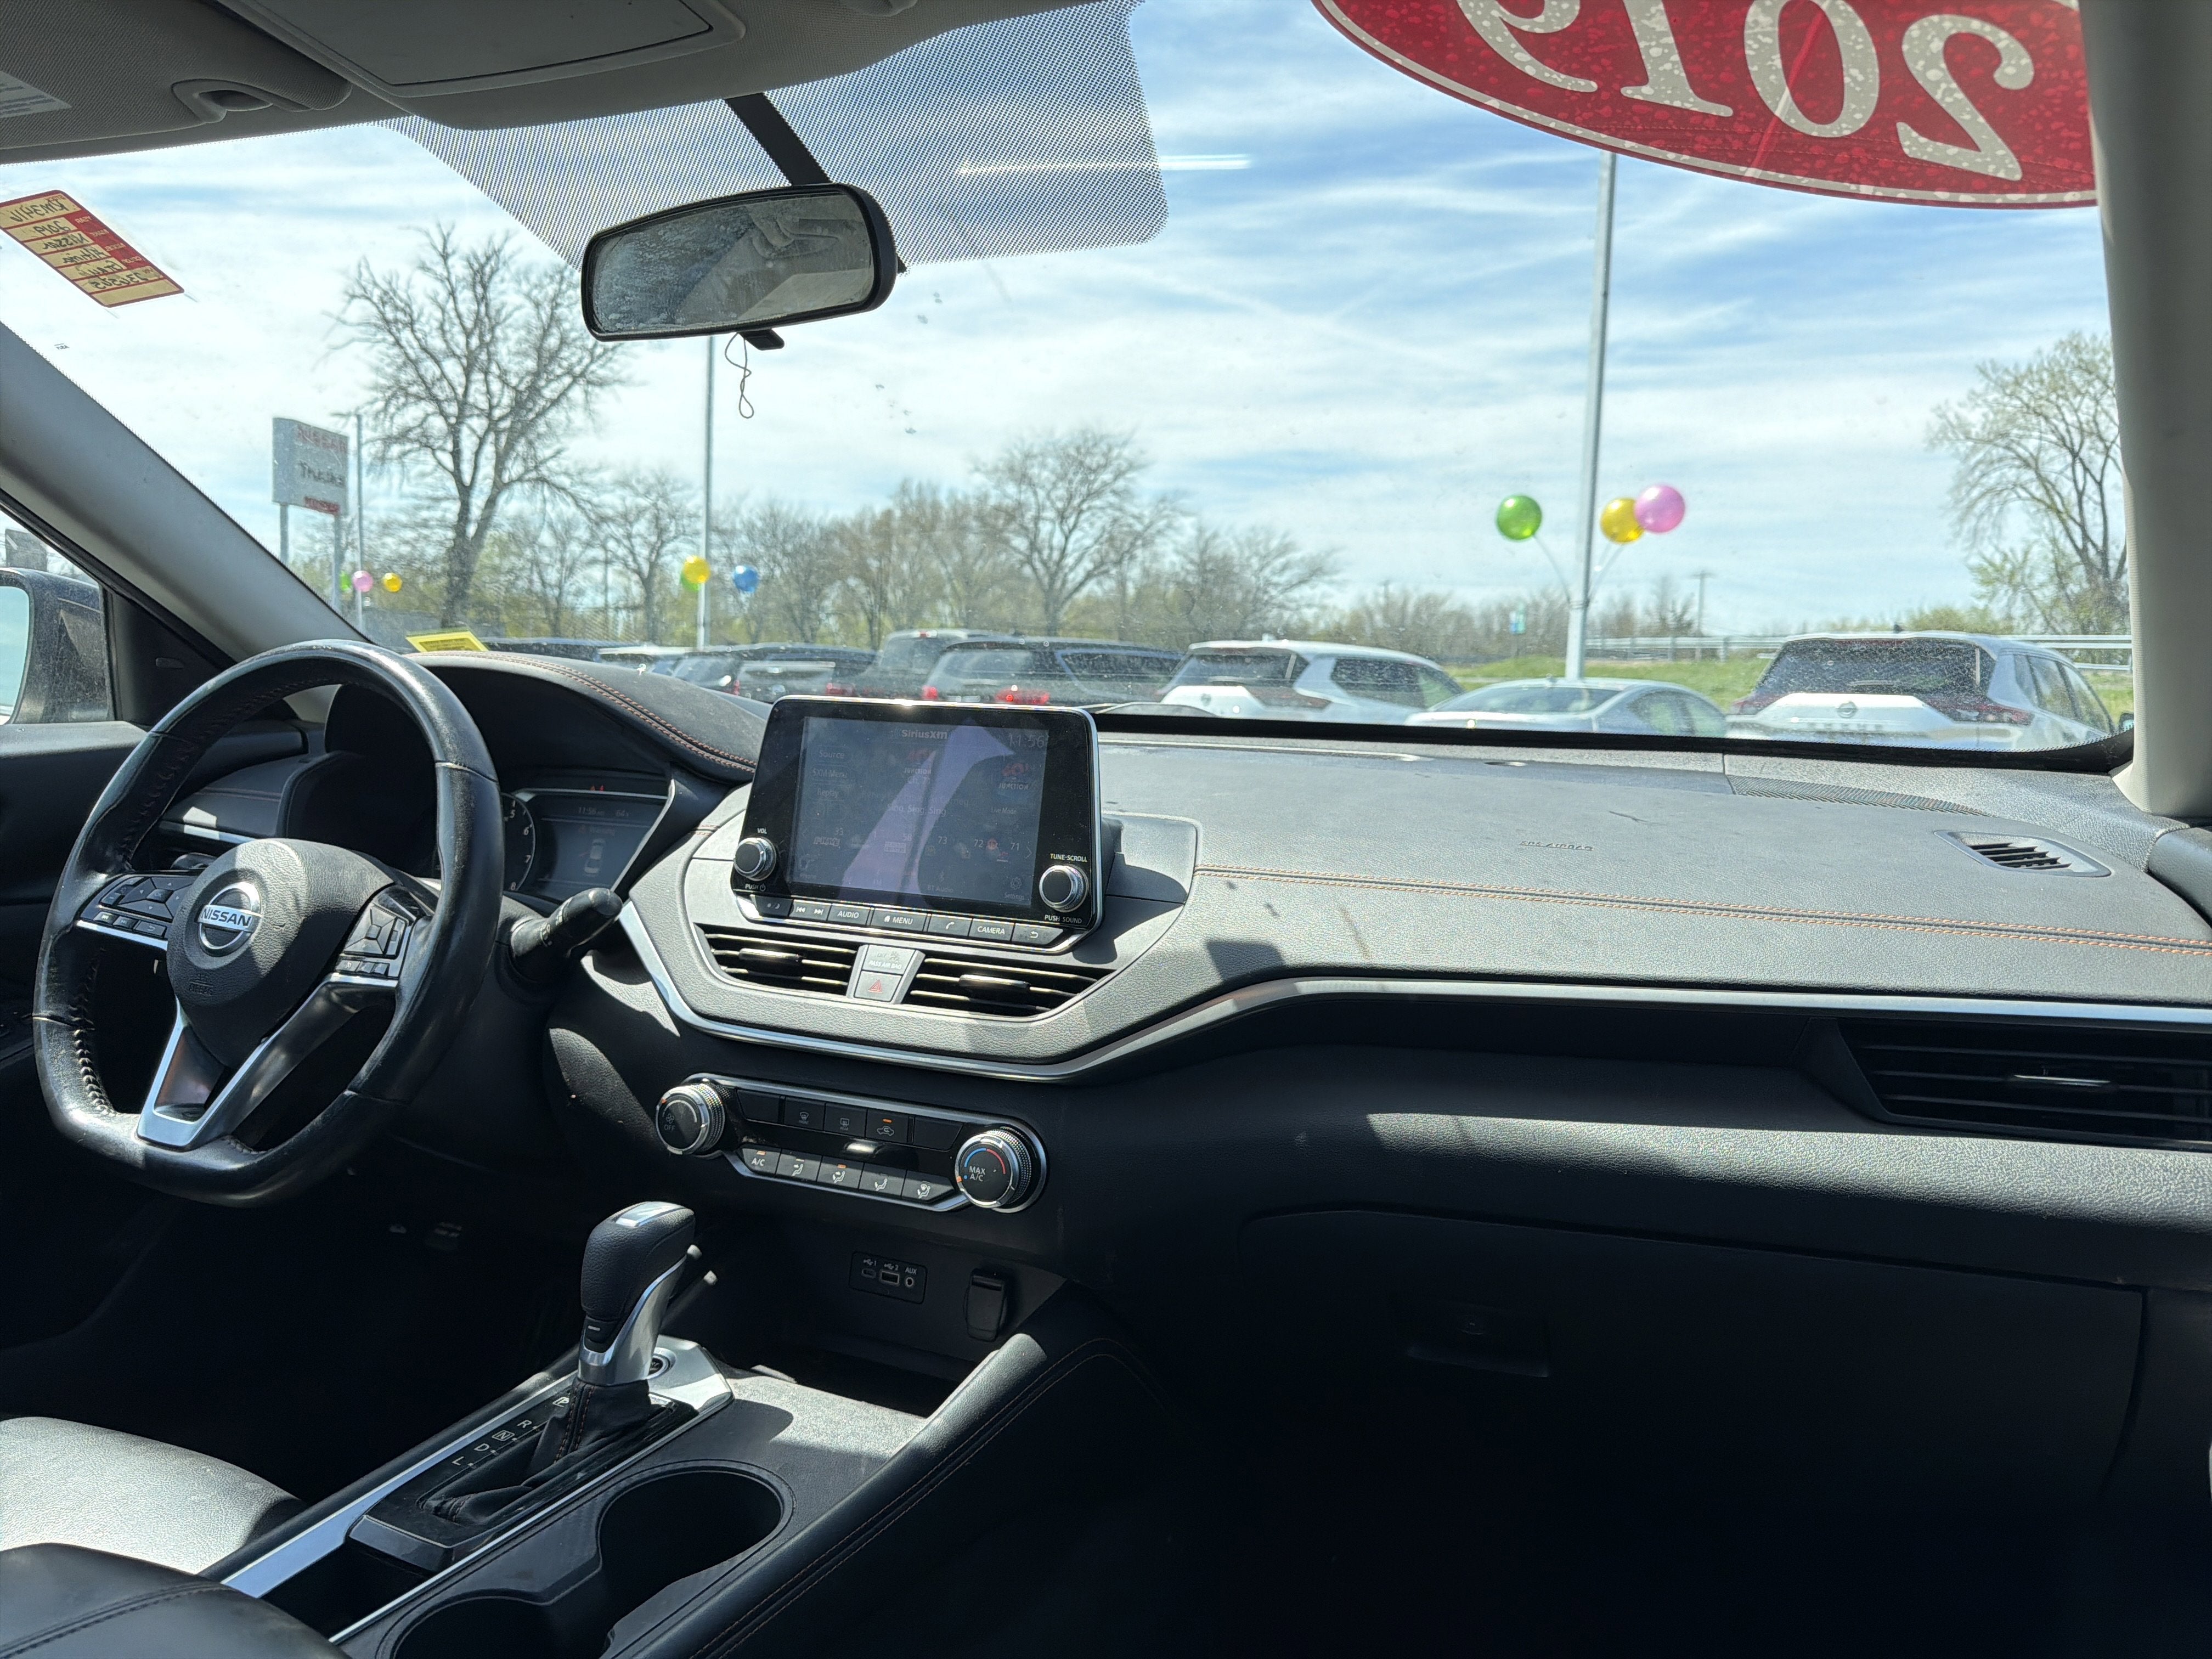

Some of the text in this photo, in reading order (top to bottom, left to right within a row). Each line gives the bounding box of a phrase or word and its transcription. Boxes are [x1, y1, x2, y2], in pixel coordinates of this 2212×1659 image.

[1009, 732, 1045, 748] 11:56
[819, 750, 845, 759] Source
[817, 788, 839, 798] Replay
[510, 809, 516, 819] 5
[928, 806, 946, 817] Sing
[938, 836, 947, 845] 73
[974, 838, 984, 848] 72
[1010, 842, 1019, 851] 71
[525, 854, 531, 863] 7
[510, 882, 516, 891] 8
[201, 908, 252, 927] NISSAN
[837, 910, 860, 919] AUDIO
[892, 916, 913, 925] MENU
[977, 926, 1005, 935] CAMERA
[751, 1157, 765, 1166] A/C
[969, 1165, 986, 1175] MAX
[969, 1173, 984, 1182] A/C
[905, 1267, 917, 1275] AUX
[516, 1419, 533, 1429] R
[473, 1443, 490, 1452] D
[452, 1457, 465, 1466] L
